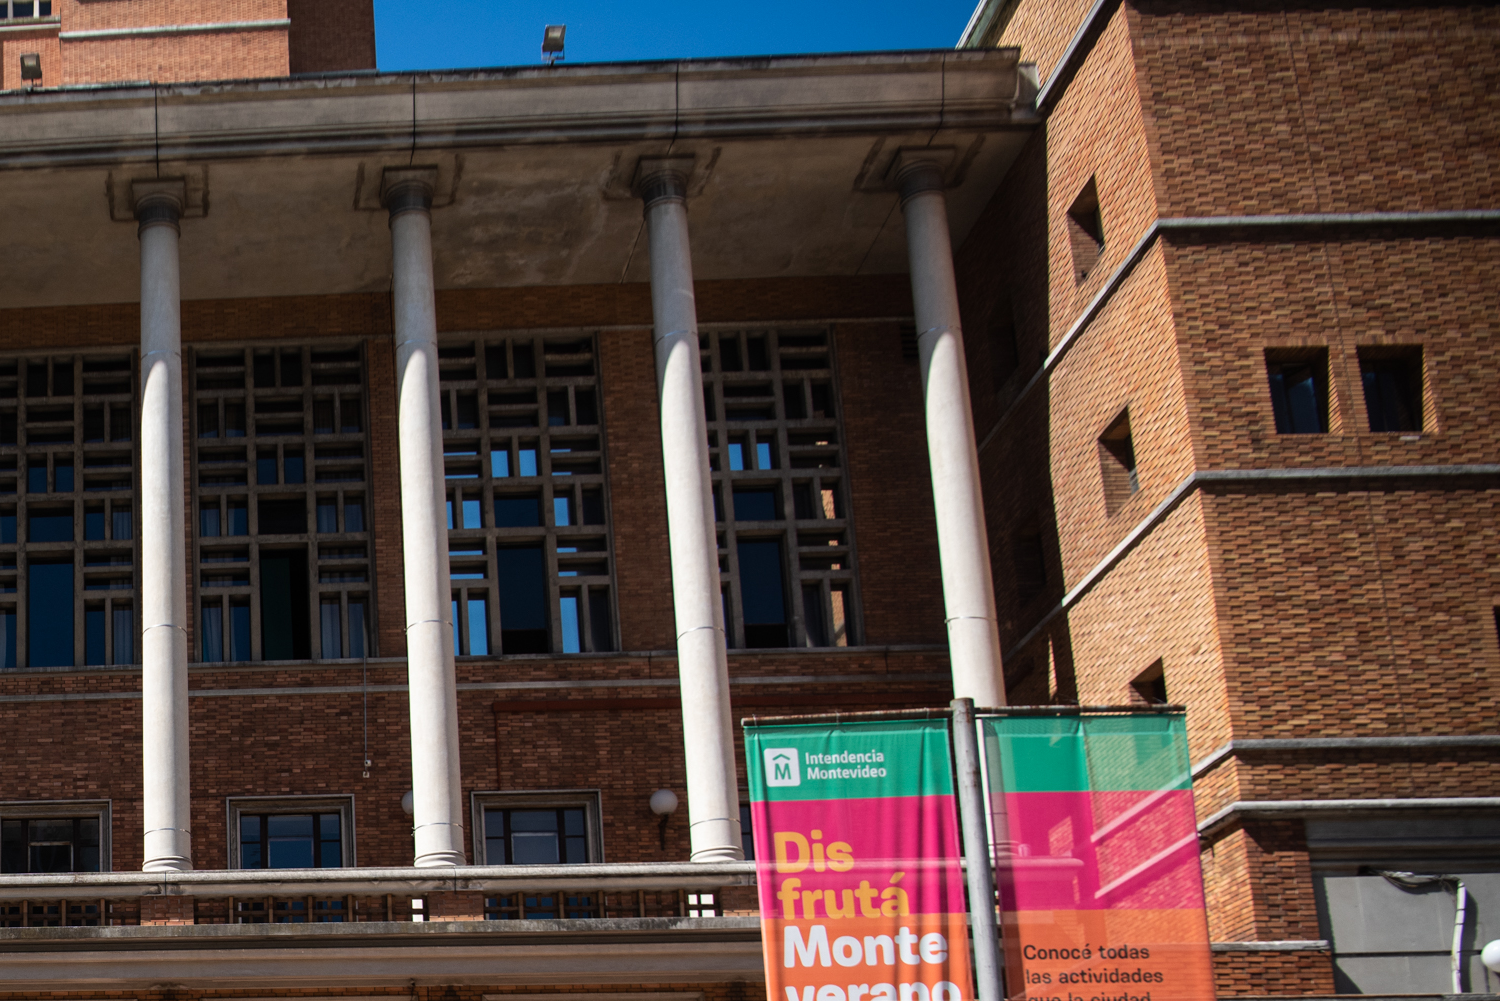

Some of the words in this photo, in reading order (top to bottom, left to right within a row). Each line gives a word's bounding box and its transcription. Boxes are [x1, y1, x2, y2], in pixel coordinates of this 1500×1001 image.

[804, 748, 885, 766] Intendencia
[806, 764, 887, 781] Montevideo
[773, 829, 854, 874] Dis
[777, 872, 910, 920] frutá
[783, 924, 949, 968] Monte
[1022, 943, 1092, 961] Conocé
[1098, 943, 1150, 960] todas
[1025, 968, 1052, 984] las
[1058, 968, 1164, 984] actividades
